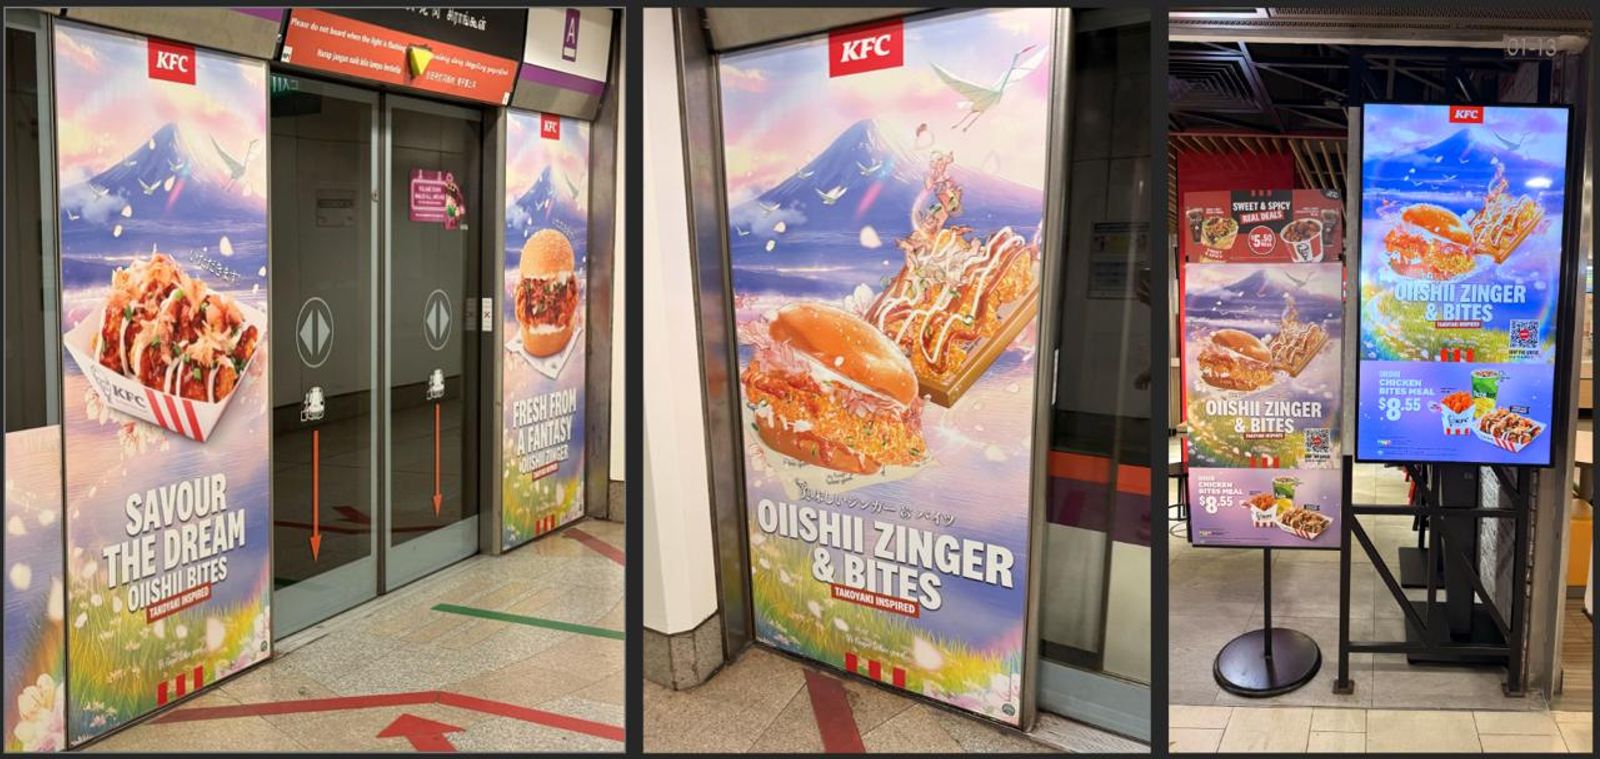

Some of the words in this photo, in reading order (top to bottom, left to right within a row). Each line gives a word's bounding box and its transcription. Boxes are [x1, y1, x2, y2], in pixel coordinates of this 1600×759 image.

[291, 18, 310, 29] Please
[310, 22, 319, 31] do
[319, 25, 330, 34] not
[330, 27, 346, 38] board
[346, 32, 361, 42] when
[361, 34, 371, 43] the
[566, 17, 576, 44] A
[839, 34, 891, 63] KFC
[1508, 38, 1557, 57] 01-13
[156, 50, 189, 73] KFC
[1454, 109, 1478, 119] KFC
[544, 119, 558, 133] KFC
[1233, 201, 1258, 212] SWEET
[1259, 201, 1267, 211] &
[1267, 200, 1291, 211] SPICY
[1260, 210, 1282, 220] DEALS
[1394, 282, 1456, 302] OIISHII
[1460, 283, 1526, 304] ZINGER
[1425, 304, 1437, 322] &
[1443, 303, 1493, 322] BITES
[1379, 379, 1422, 387] CHICKEN
[1379, 387, 1407, 395] BITES
[1408, 387, 1435, 396] MEAL
[112, 384, 146, 408] KFC
[513, 396, 547, 428] FRESH
[551, 388, 576, 416] FROM
[1206, 400, 1260, 416] OIISHII
[1264, 401, 1322, 418] ZINGER
[1379, 397, 1421, 421] $8.55
[517, 429, 525, 455] A
[527, 417, 572, 453] FANTASY
[1234, 418, 1245, 433] &
[1251, 418, 1295, 434] BITES
[126, 473, 227, 536] SAVOUR
[1199, 495, 1233, 514] $8.55
[103, 535, 157, 590] THE
[164, 508, 245, 572] DREAM
[757, 498, 864, 554] OIISHII
[874, 521, 1015, 589] ZINGER
[128, 570, 183, 613] OIISHII
[187, 556, 228, 588] BITES
[812, 547, 835, 584] &
[845, 553, 943, 612] BITES
[834, 587, 875, 605] TAKOYAKI
[875, 595, 916, 615] INSPIRED
